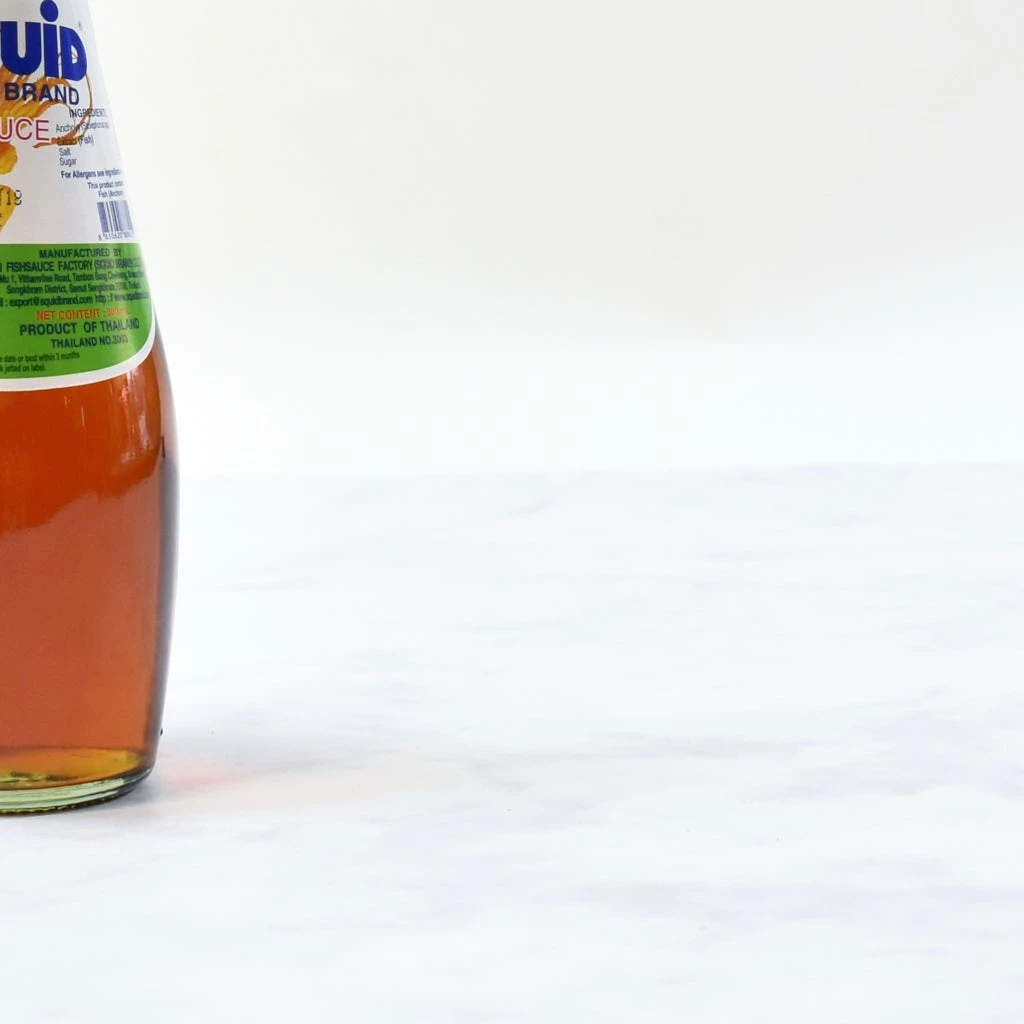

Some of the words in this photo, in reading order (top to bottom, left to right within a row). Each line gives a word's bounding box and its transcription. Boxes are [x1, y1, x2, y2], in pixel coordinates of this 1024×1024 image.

[4, 82, 80, 105] BRAND
[59, 147, 71, 156] Salt
[59, 157, 77, 167] Sugar
[40, 248, 110, 259] MANUFACTURED
[113, 248, 121, 257] BY
[6, 261, 55, 272] FISHSAUCE
[58, 260, 92, 271] FACTORY
[9, 295, 93, 309] export@squidbrand.com
[36, 310, 56, 321] NET
[59, 309, 101, 320] CONTENT
[20, 322, 78, 336] PRODUCT
[83, 321, 97, 334] OF
[100, 318, 140, 332] THAILAND
[50, 336, 98, 349] THAILAND
[3, 354, 16, 362] date
[22, 364, 30, 372] on
